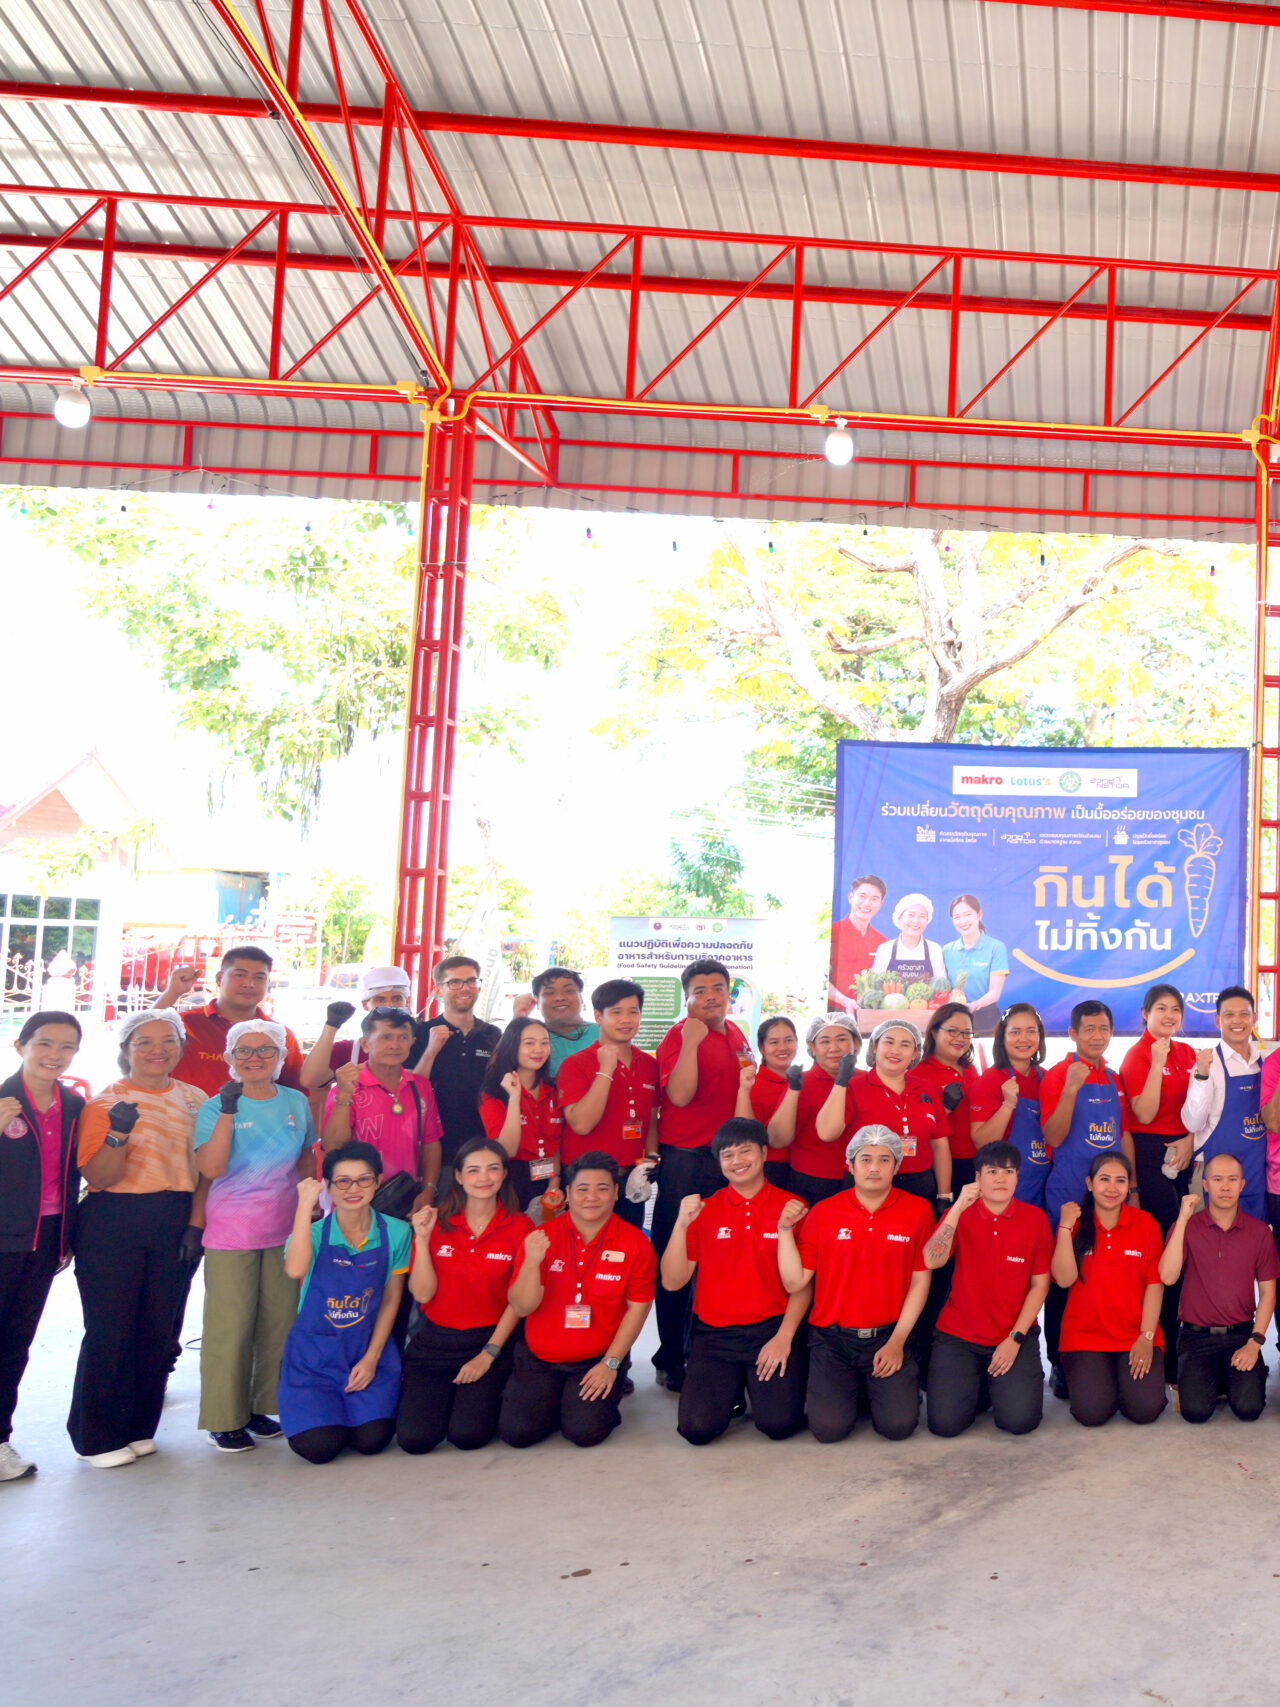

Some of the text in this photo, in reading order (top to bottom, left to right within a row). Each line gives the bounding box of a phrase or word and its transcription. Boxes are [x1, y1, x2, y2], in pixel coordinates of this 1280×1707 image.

[961, 773, 1051, 786] makro Lotus's
[1071, 802, 1205, 824] เป็นมื้ออร่อยของชุมชน
[1033, 855, 1176, 909] กินได้
[1034, 912, 1172, 951] ไม่ทิ้งกัน
[619, 936, 753, 950] แนวปฏิบัติเพื่อความปลอดภัย
[886, 1233, 910, 1243] makro
[486, 1252, 513, 1261] makro
[1006, 1255, 1025, 1263] makro
[595, 1272, 621, 1282] makro
[326, 1295, 361, 1309] กินได้
